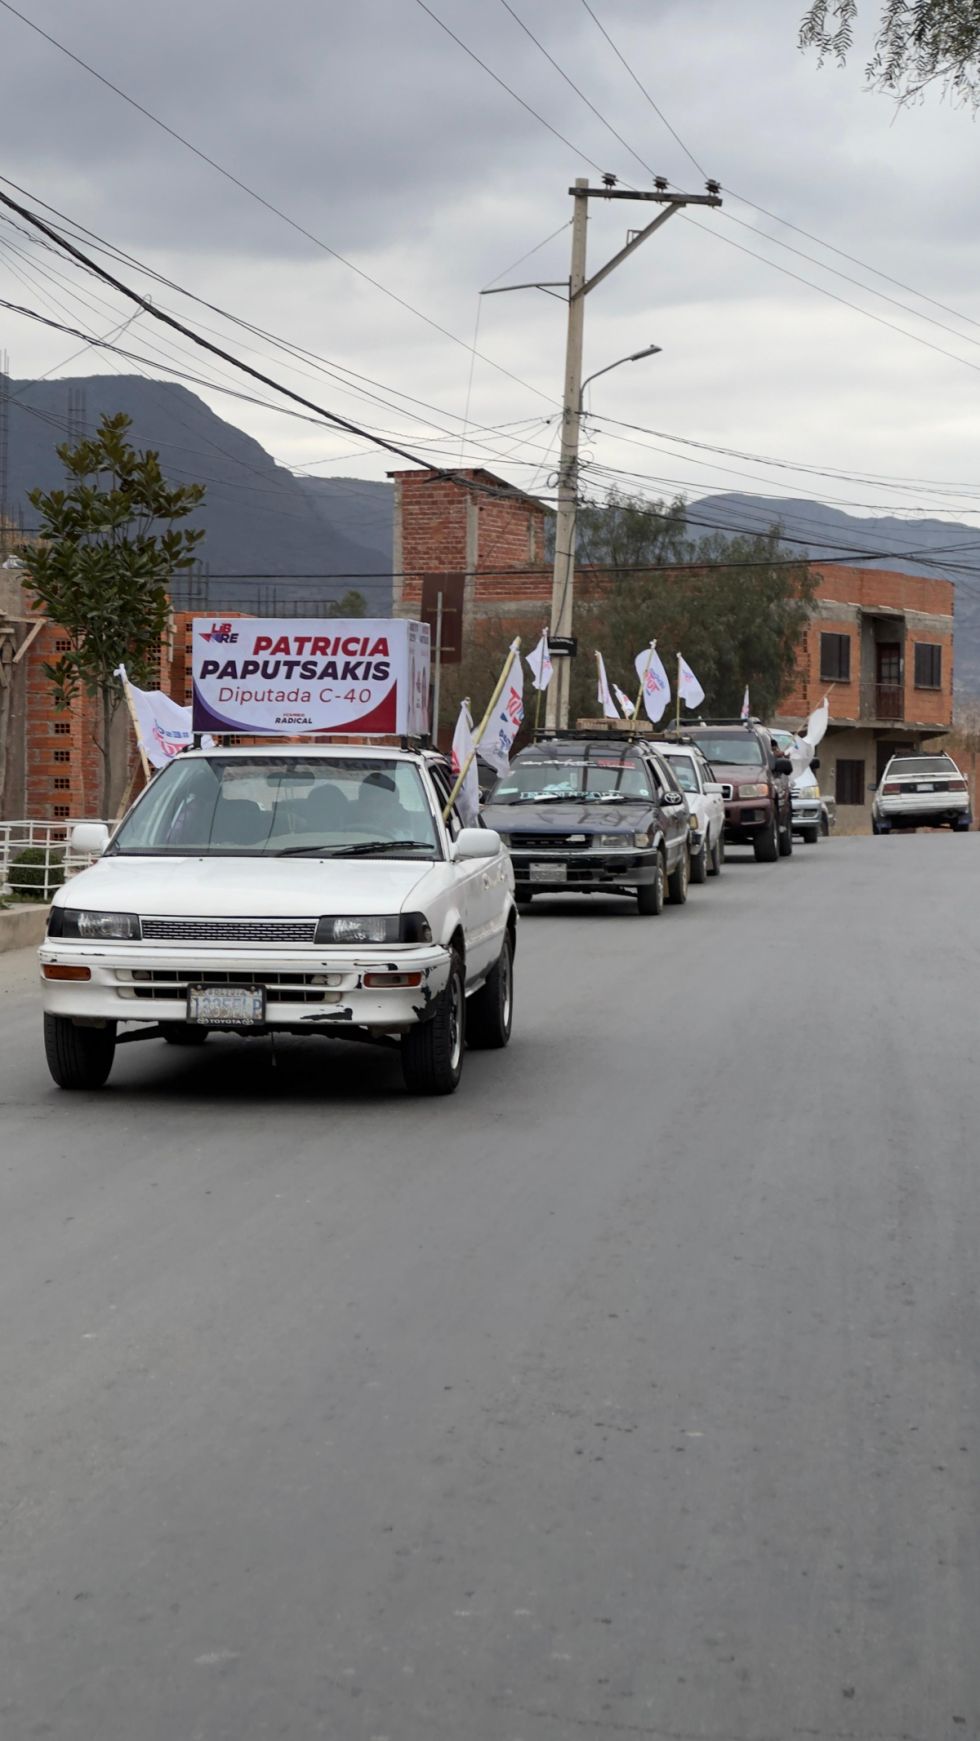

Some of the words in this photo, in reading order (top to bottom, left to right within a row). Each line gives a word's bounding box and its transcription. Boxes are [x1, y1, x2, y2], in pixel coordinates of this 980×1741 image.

[252, 635, 390, 657] PATRICIA
[199, 660, 391, 681] PAPUTSAKIS
[218, 686, 311, 705] Diputada
[319, 687, 372, 704] C-40
[274, 717, 313, 725] RADICAL
